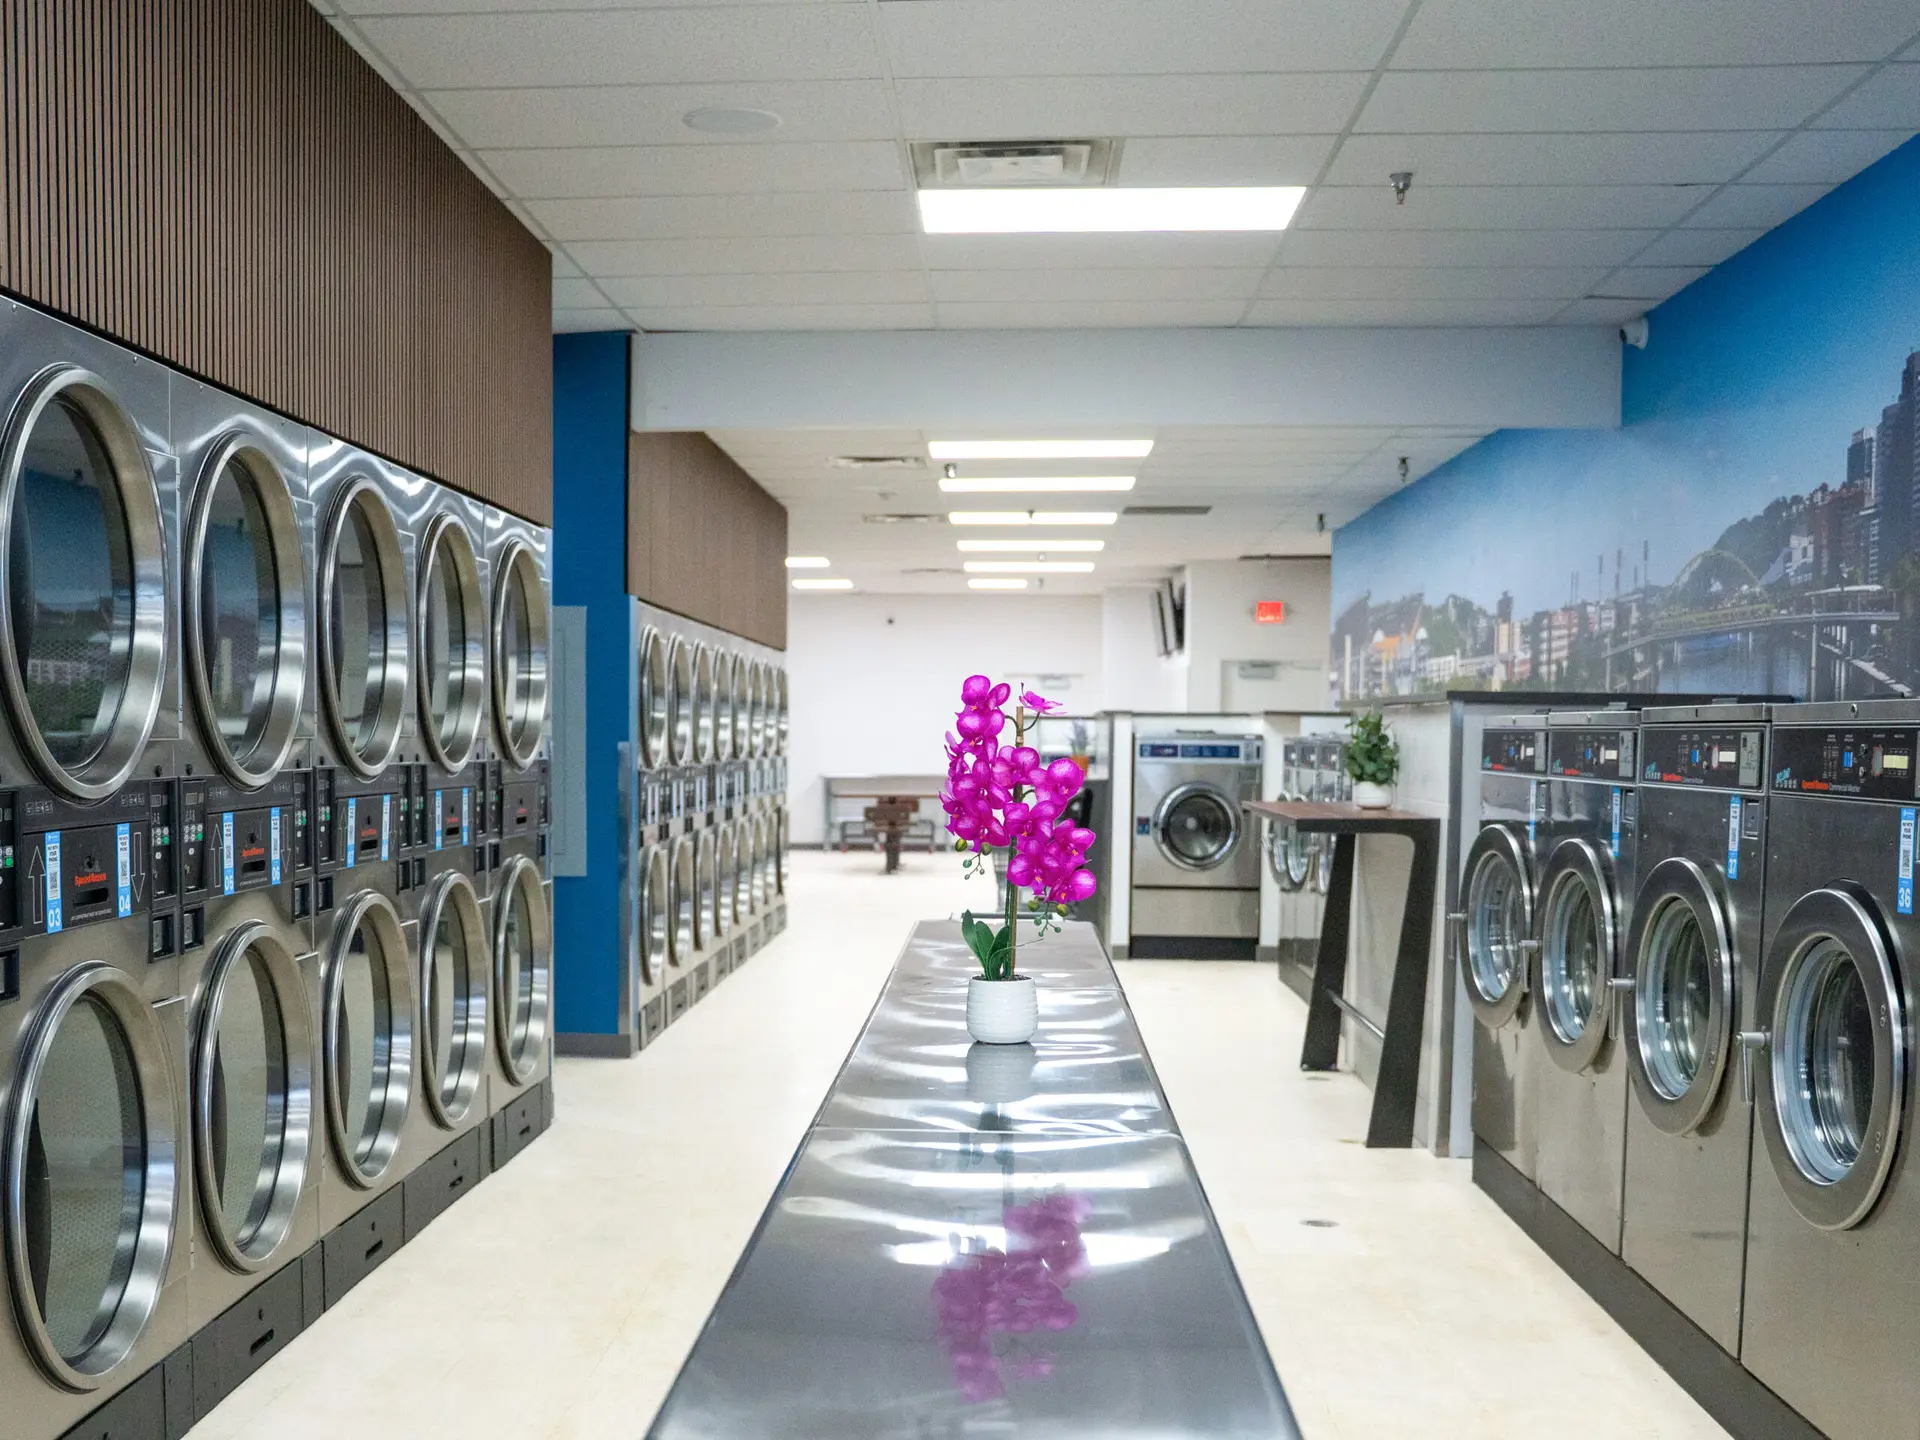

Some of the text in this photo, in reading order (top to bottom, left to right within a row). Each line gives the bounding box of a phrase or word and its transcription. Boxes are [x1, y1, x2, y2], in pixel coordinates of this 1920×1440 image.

[224, 874, 234, 891] 05
[119, 894, 131, 913] 04
[1899, 887, 1911, 908] 36
[48, 907, 61, 928] 03
